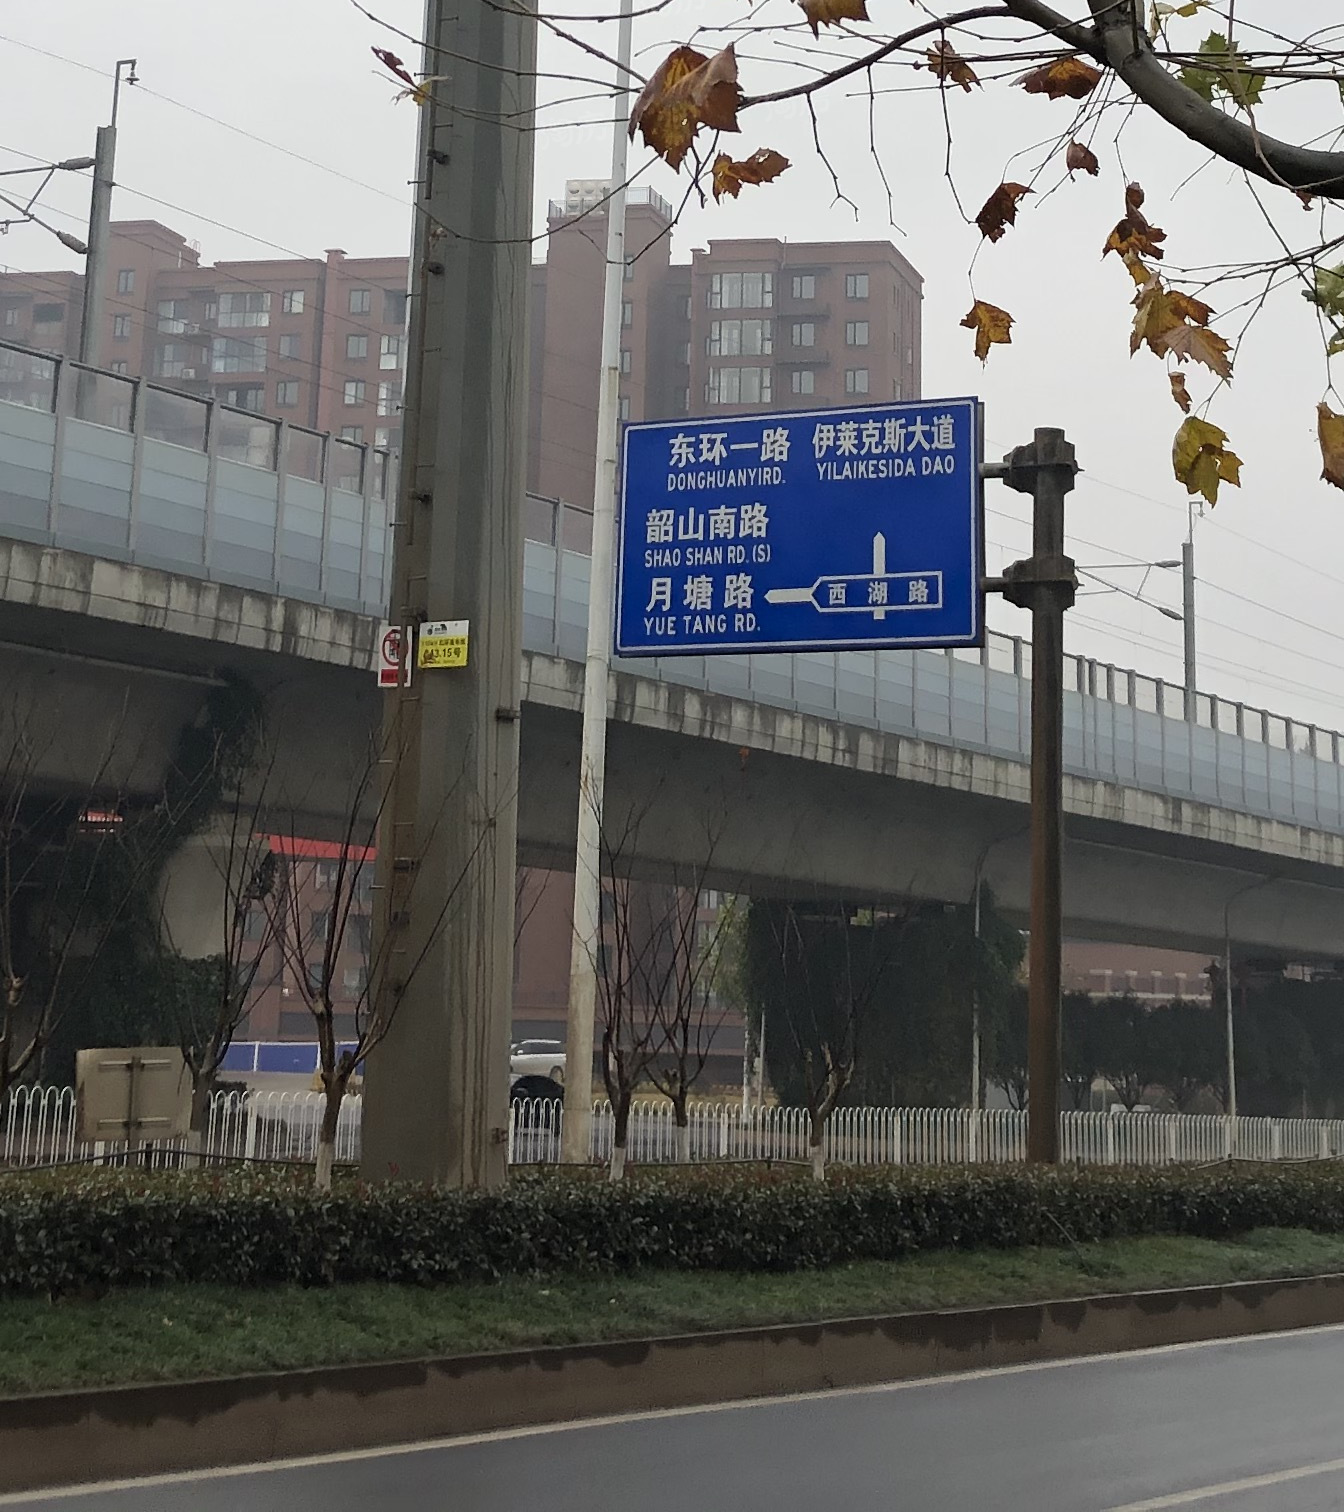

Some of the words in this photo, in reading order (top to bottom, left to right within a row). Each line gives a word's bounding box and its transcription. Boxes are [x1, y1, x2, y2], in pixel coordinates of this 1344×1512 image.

[668, 426, 792, 468] 东环一路
[812, 413, 956, 459] 伊莱克斯大道
[816, 457, 917, 481] YILAIKESIDA
[921, 454, 955, 476] DAO
[645, 501, 770, 544] 韶山南路
[644, 548, 681, 568] SHAO
[685, 546, 723, 566] SHAN
[645, 572, 755, 612] 月塘路
[827, 579, 929, 605] 西湖路
[643, 616, 677, 636] YUE
[683, 614, 727, 634] TANG
[734, 613, 761, 633] RD.
